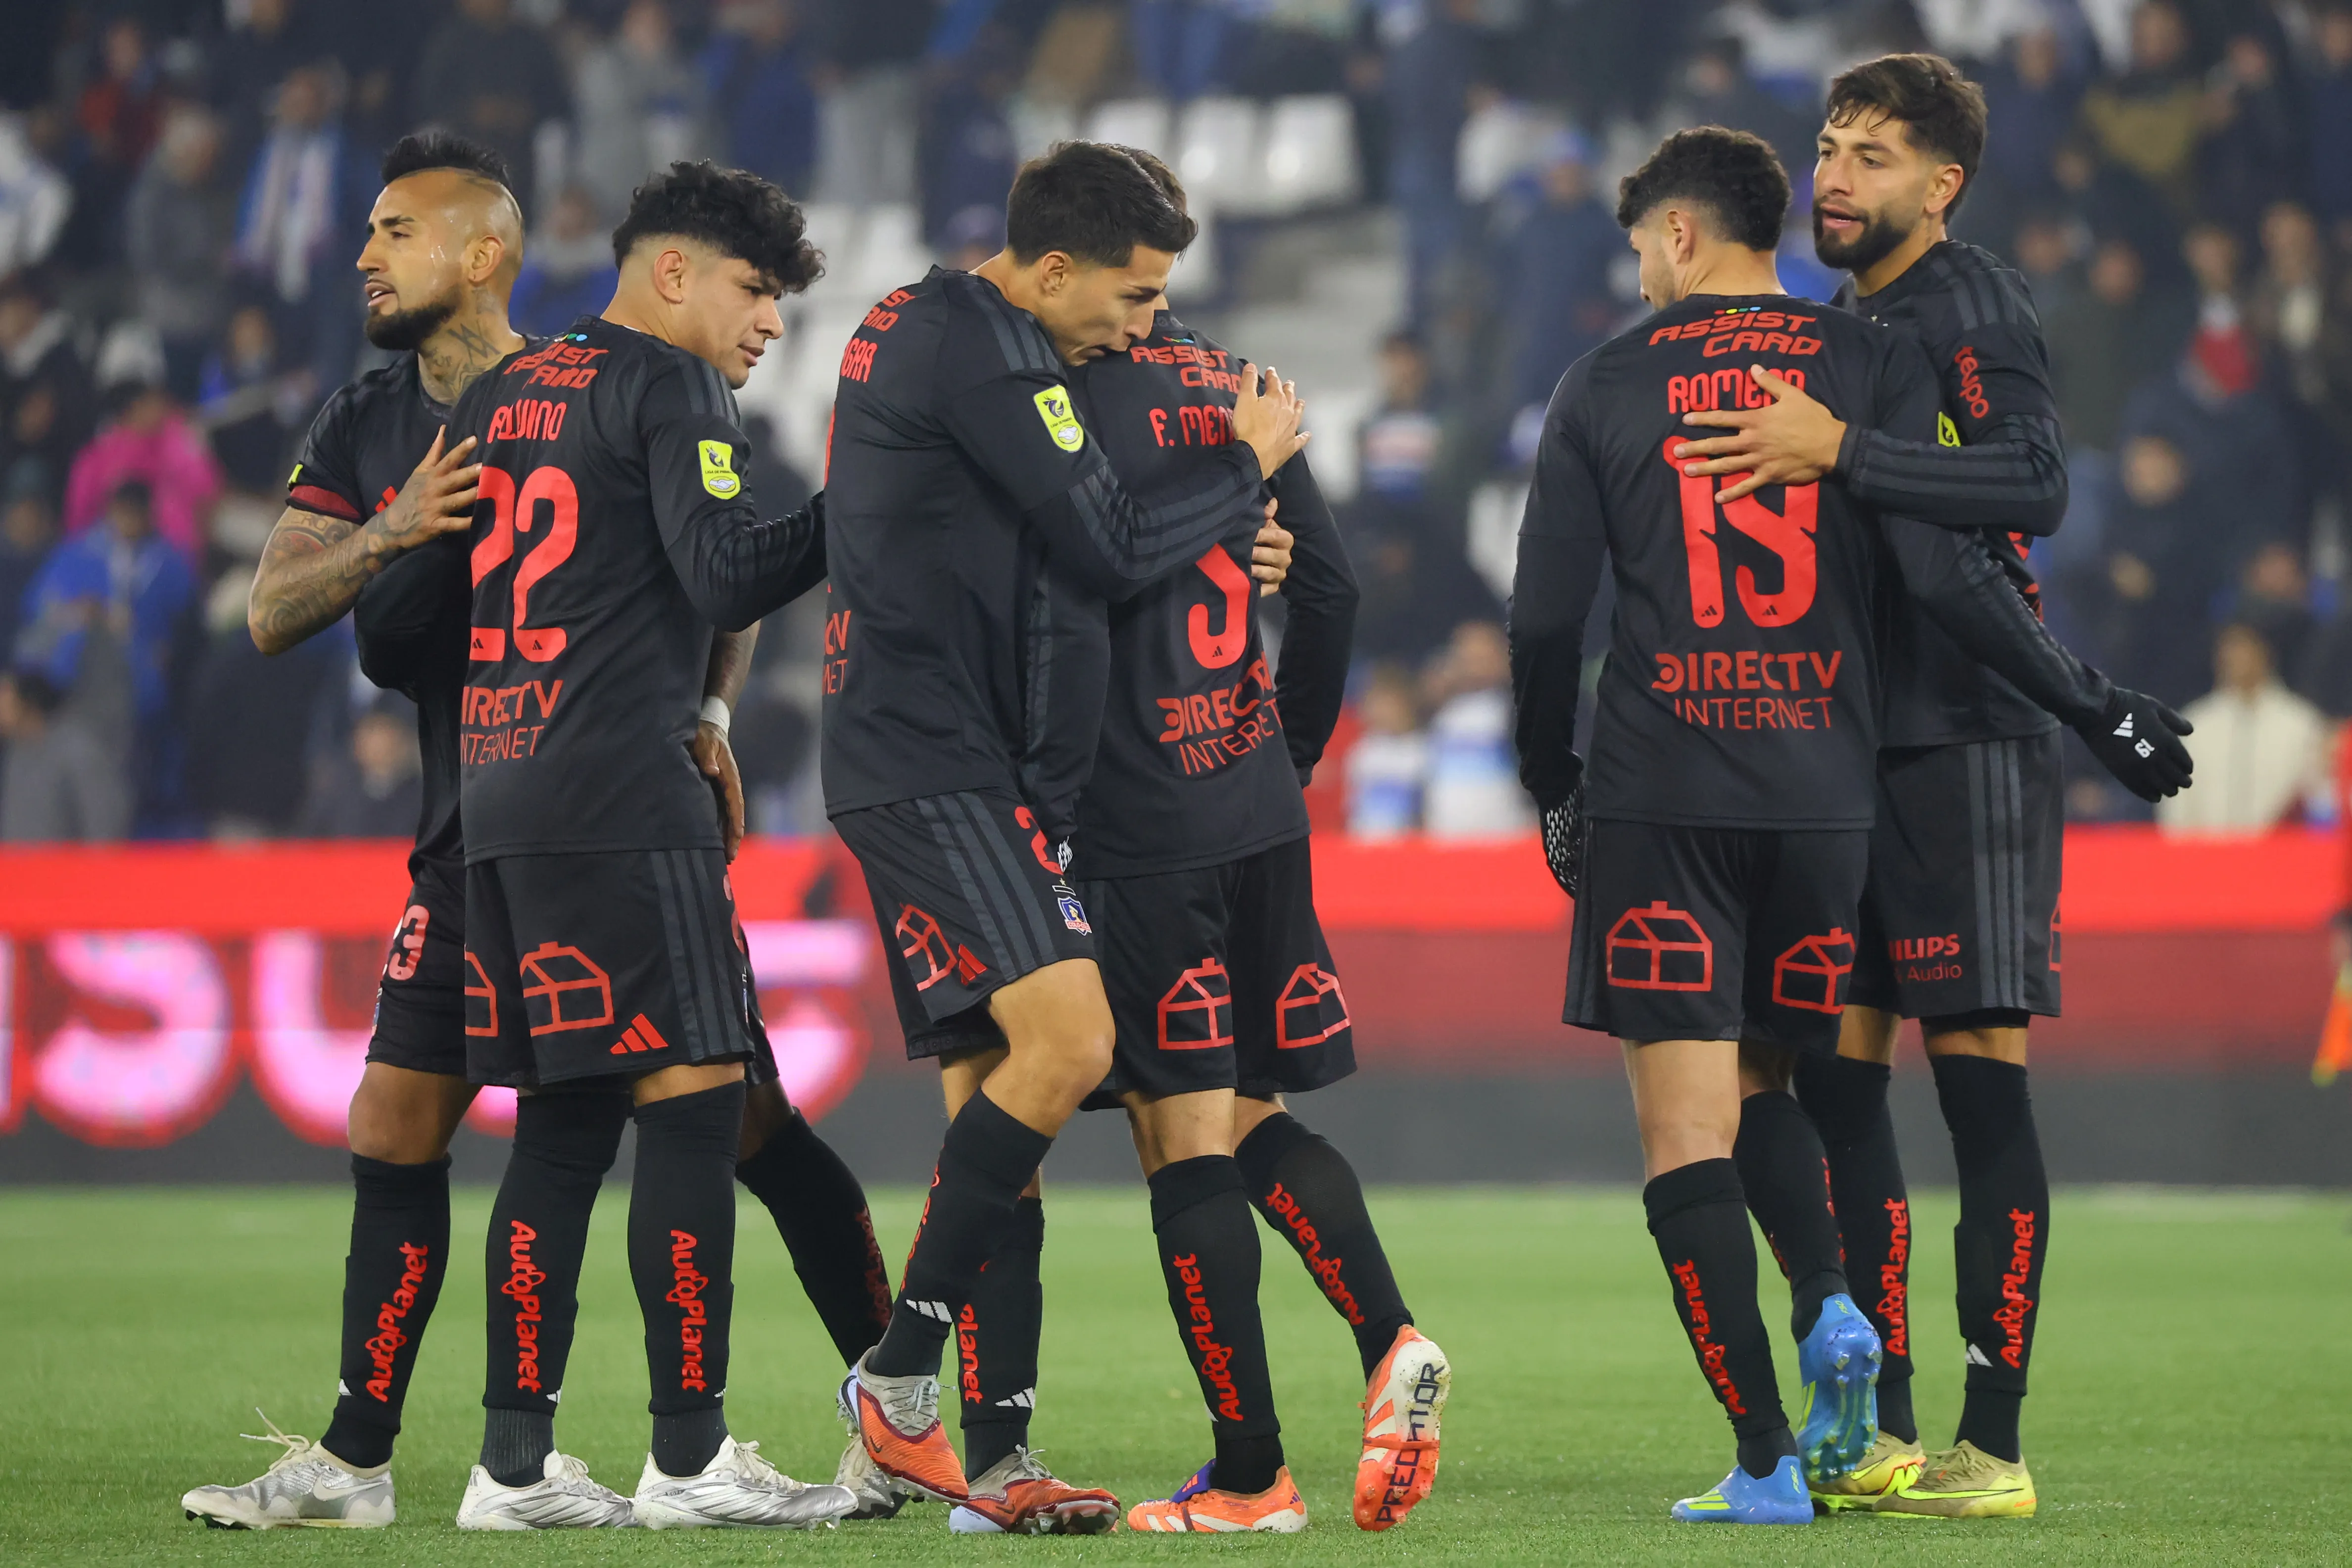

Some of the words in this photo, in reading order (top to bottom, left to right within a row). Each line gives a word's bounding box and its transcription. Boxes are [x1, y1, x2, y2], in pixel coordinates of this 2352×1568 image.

[1648, 312, 1817, 345] ASSIST
[1703, 331, 1823, 358] CARD
[503, 342, 609, 375] ASIST
[1130, 346, 1228, 368] ASSIST
[522, 365, 598, 390] ARD
[1149, 408, 1175, 447] F.
[1179, 405, 1235, 446] MEN
[1663, 435, 1820, 629] 19
[470, 466, 579, 662] 22
[1652, 651, 1842, 693] DIRECTV
[1675, 697, 1832, 730] INTERNET
[461, 725, 545, 765] NTERNET
[2134, 738, 2155, 758] 19
[1889, 933, 1961, 961] ILIPS
[1908, 961, 1963, 982] Audio
[365, 1242, 428, 1402] AutoPlanet
[501, 1220, 546, 1393] AutoPlanet
[666, 1230, 708, 1392] AutoPlanet
[1174, 1253, 1243, 1421] AutoPlanet
